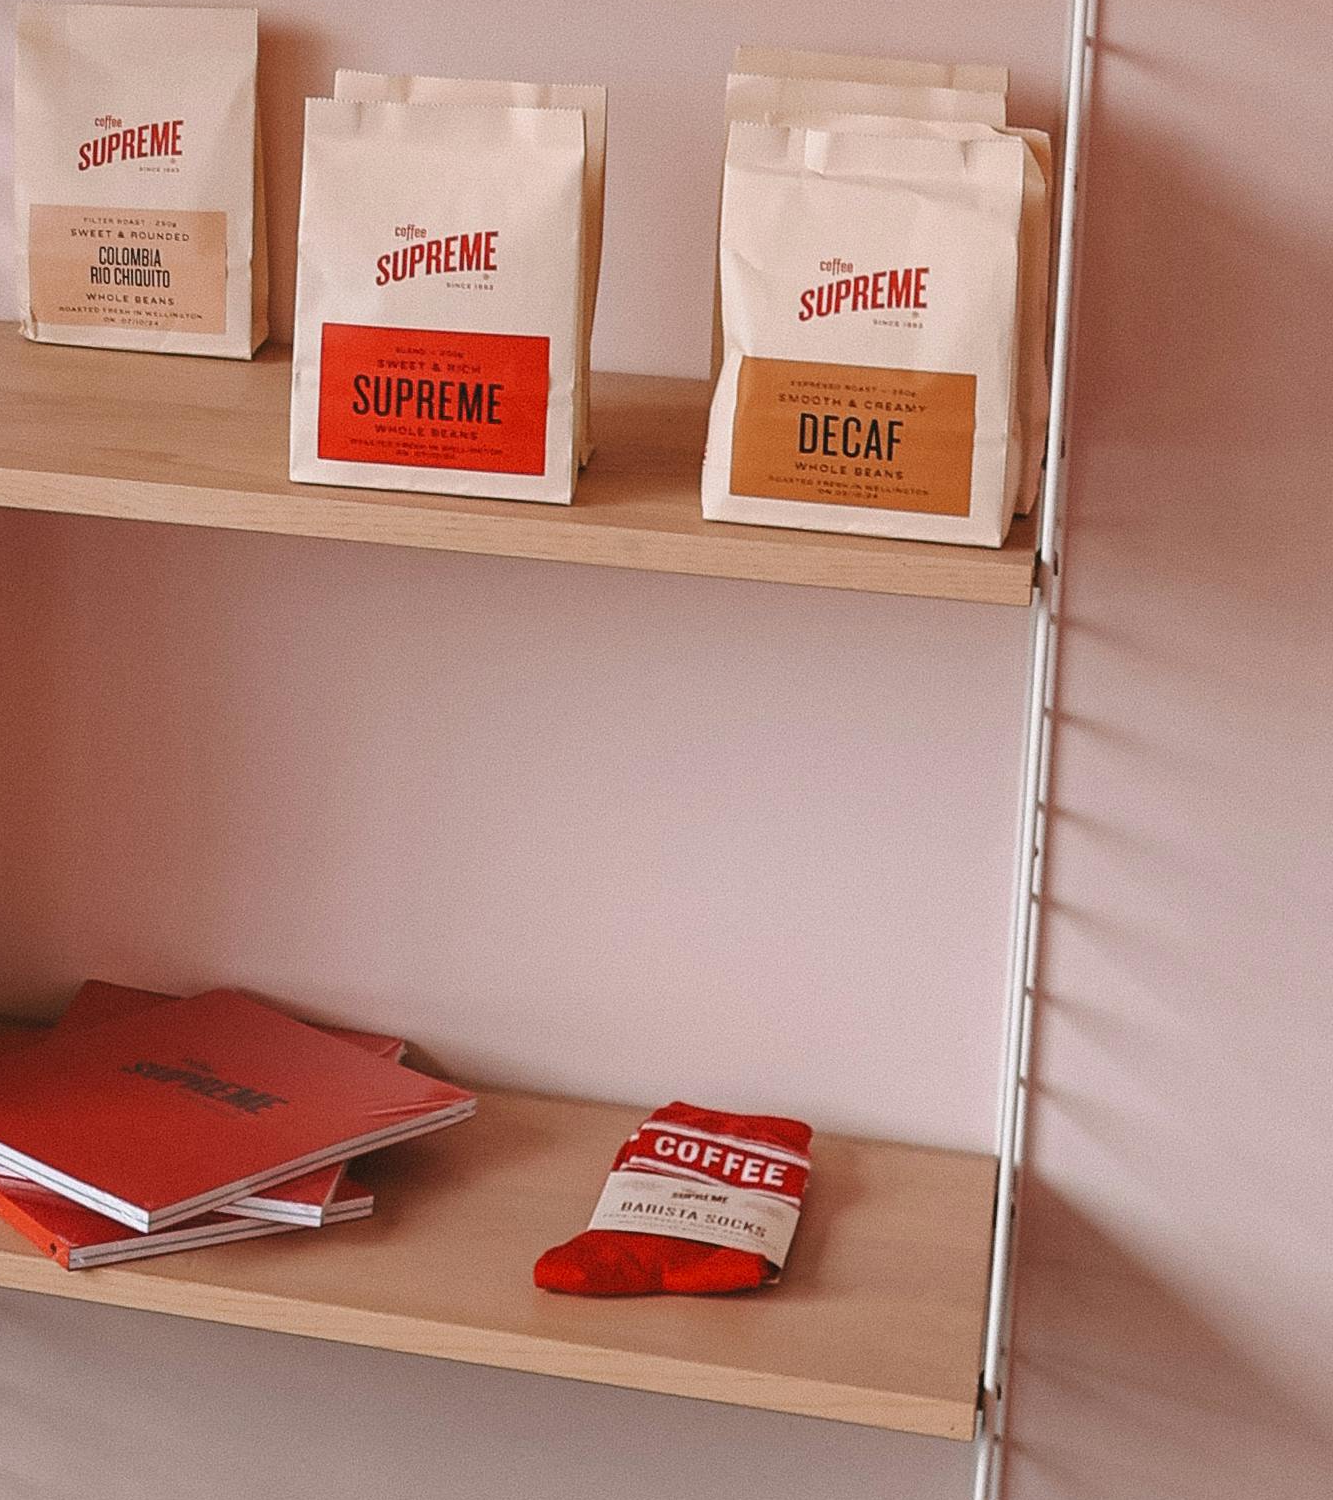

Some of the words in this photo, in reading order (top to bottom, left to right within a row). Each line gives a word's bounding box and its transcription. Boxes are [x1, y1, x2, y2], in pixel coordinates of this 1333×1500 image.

[94, 114, 123, 132] coffee
[77, 119, 185, 171] SUPREME
[70, 228, 112, 239] SWEET
[130, 231, 191, 242] ROUNDED
[394, 223, 428, 241] coffee
[99, 246, 163, 268] COLOMBIA
[375, 230, 499, 286] SUPREME
[819, 258, 854, 276] coffee
[90, 266, 111, 286] RIO
[114, 266, 172, 288] CHIQUITO
[85, 291, 130, 303] WHOLE
[134, 295, 176, 307] BEANS
[798, 266, 929, 322] SUPREME
[352, 373, 506, 425] SUPREME
[778, 393, 842, 407] SMOOTH
[863, 400, 928, 413] CREAMY
[798, 411, 904, 461] DECAF
[794, 462, 848, 476] WHOLE
[853, 466, 905, 480] BEANS
[654, 1135, 789, 1187] COFFEE
[620, 1201, 699, 1221] BARISTA
[704, 1213, 768, 1239] SOCKS
